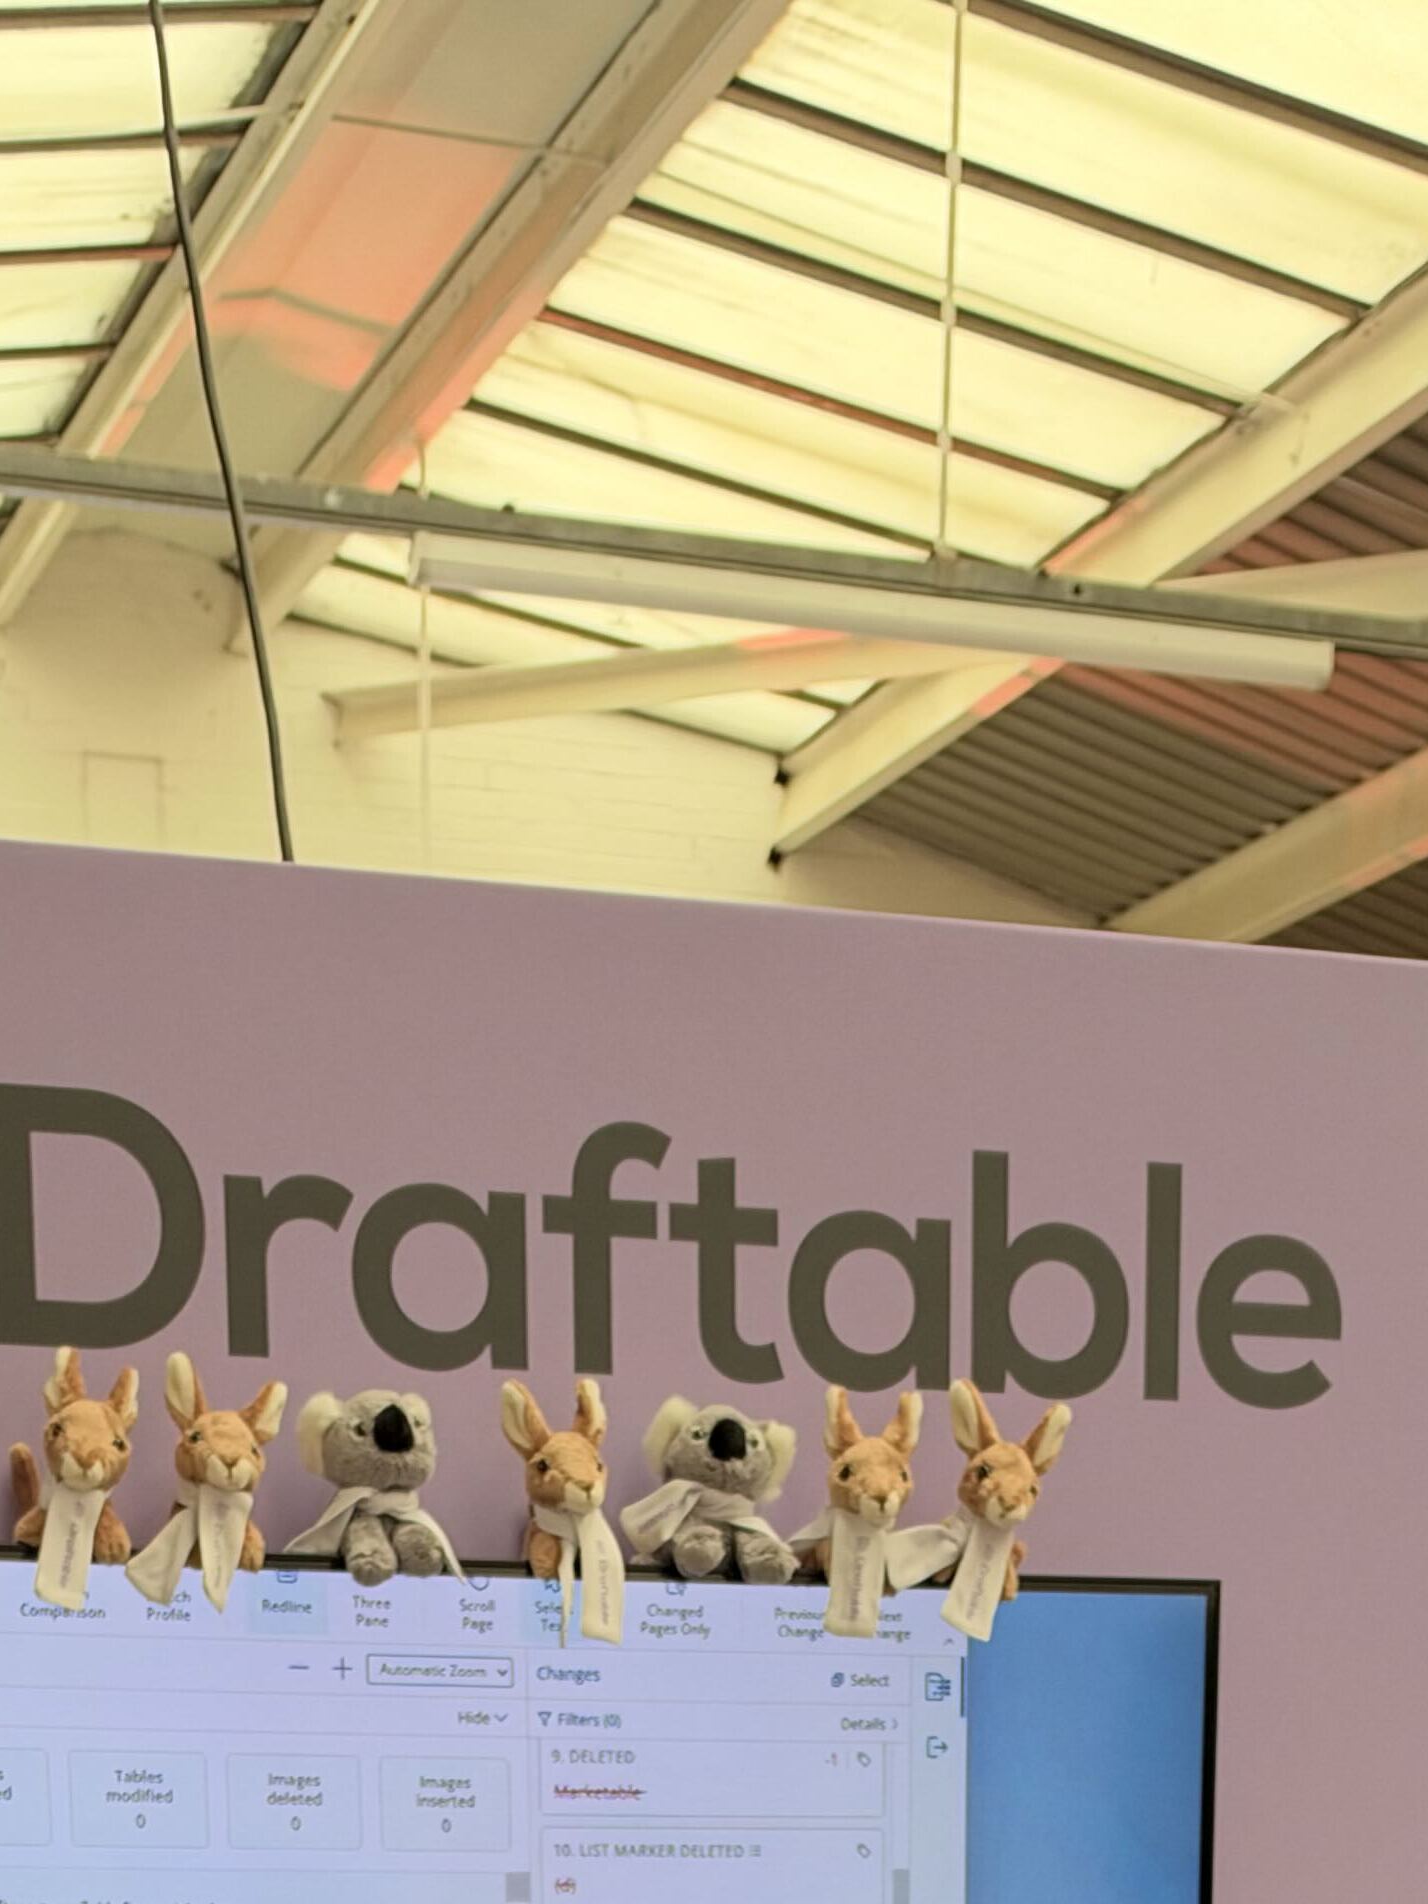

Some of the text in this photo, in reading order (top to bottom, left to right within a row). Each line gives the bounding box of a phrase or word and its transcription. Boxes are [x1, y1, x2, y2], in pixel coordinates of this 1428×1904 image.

[262, 1600, 313, 1614] Redline
[352, 1596, 392, 1610] Three
[459, 1599, 496, 1613] Scroll
[146, 1607, 191, 1621] Profile
[646, 1604, 703, 1621] Changed
[355, 1614, 389, 1628] Pane
[462, 1617, 494, 1633] Page
[639, 1621, 711, 1638] Pages Only
[380, 1663, 487, 1678] Automatic Zoom
[536, 1666, 601, 1684] Changes
[850, 1674, 890, 1688] Select
[458, 1710, 491, 1725] Hide
[557, 1713, 622, 1729] Filters (0)
[840, 1716, 886, 1731] Details
[551, 1750, 636, 1765] 9. DELETED
[114, 1769, 163, 1785] Tables
[268, 1773, 320, 1791] Images
[419, 1775, 471, 1794] Images
[105, 1788, 174, 1804] modified
[267, 1791, 323, 1806] deleted
[416, 1794, 475, 1808] inserted
[136, 1814, 146, 1830] 0
[290, 1816, 301, 1831] 0
[441, 1819, 452, 1834] 0
[579, 1844, 609, 1858] LIST
[614, 1844, 675, 1858] MARKER
[680, 1844, 745, 1859] DELETED
